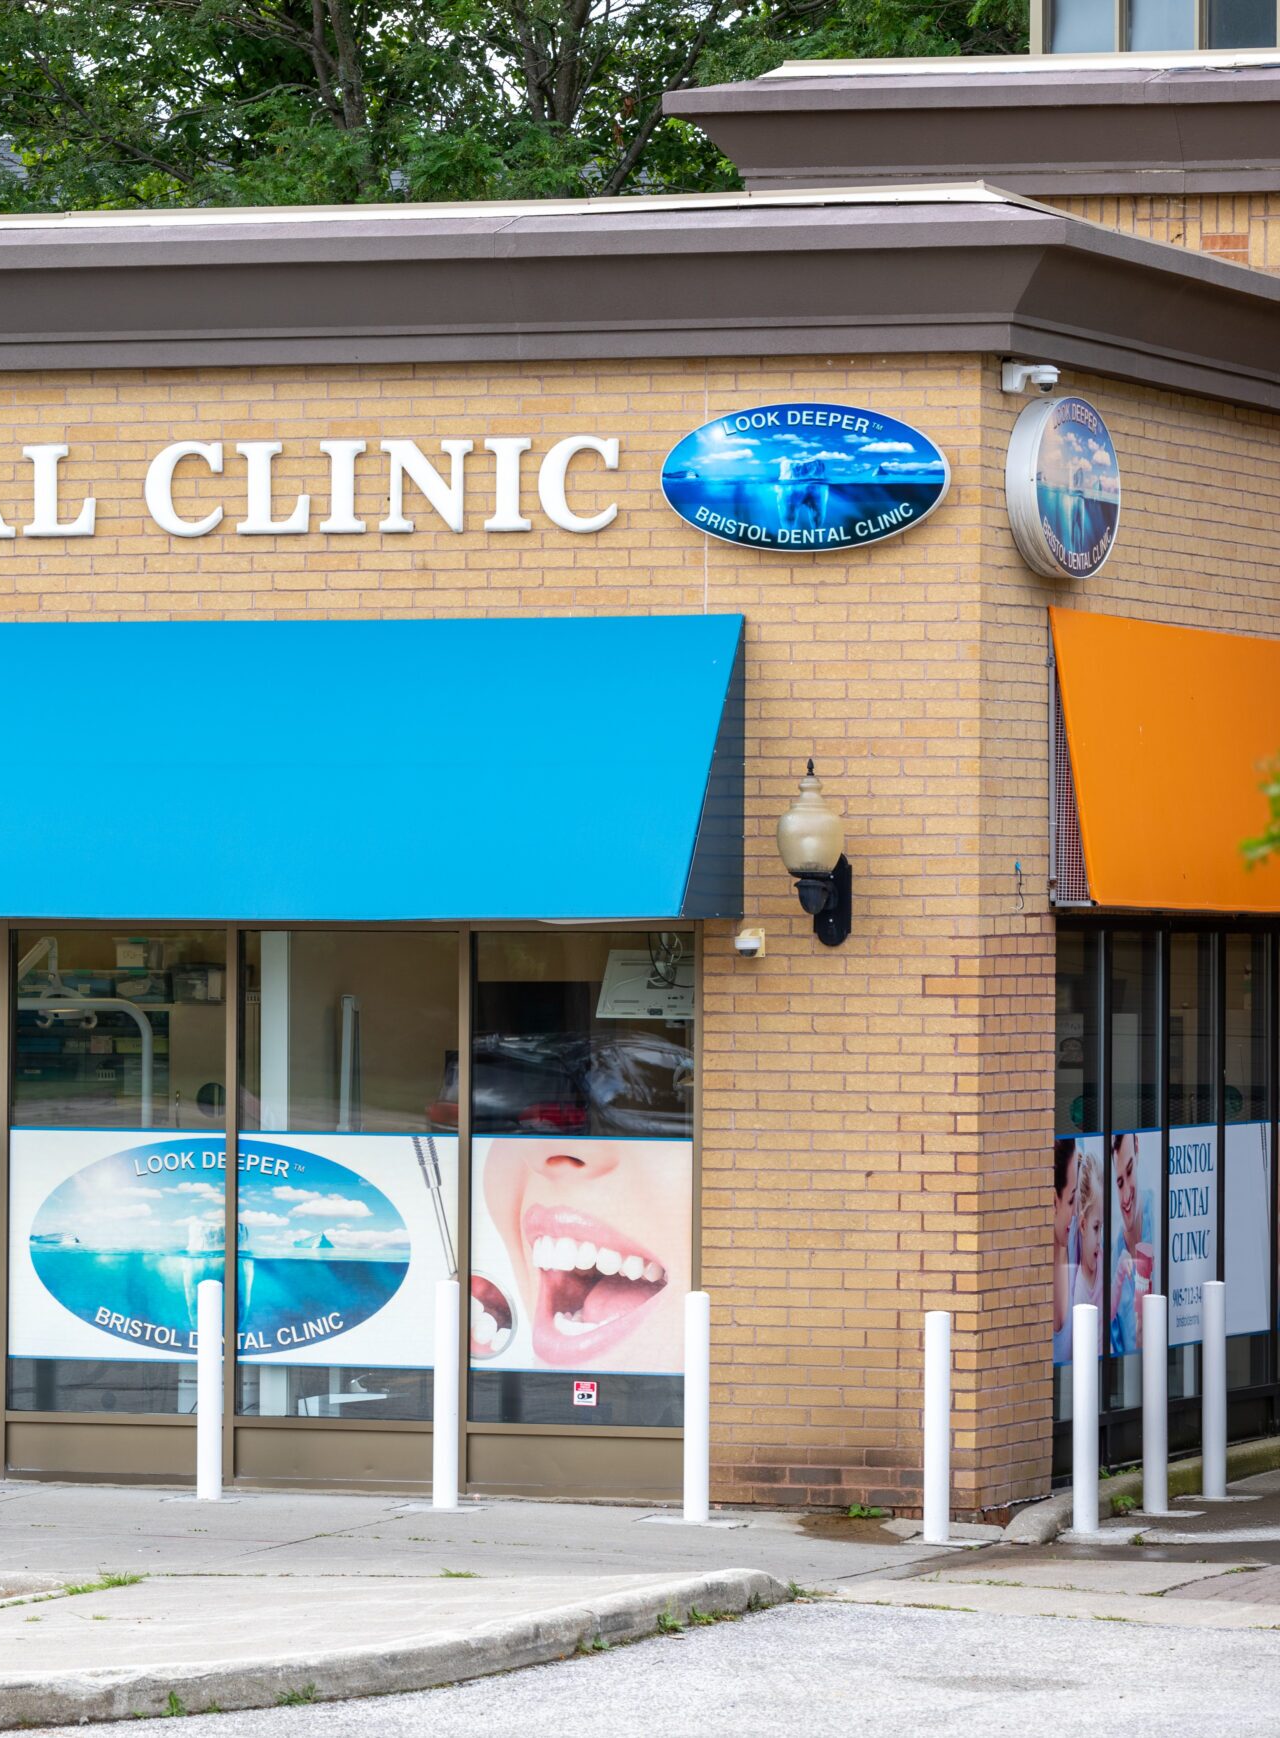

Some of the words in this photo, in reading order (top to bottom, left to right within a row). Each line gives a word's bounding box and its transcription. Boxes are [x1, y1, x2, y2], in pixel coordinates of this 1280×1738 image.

[723, 412, 780, 436] LOOK
[787, 411, 869, 433] DEEPER
[1053, 403, 1070, 429] LOOK
[1072, 403, 1097, 435] DEEPER
[145, 435, 619, 537] CLINIC
[695, 506, 771, 542] BRISTOL
[777, 526, 851, 544] DENTAL
[855, 502, 914, 537] CLINIC
[1042, 517, 1068, 565] BRISTOL
[1068, 550, 1093, 571] DENTAL
[1092, 527, 1112, 564] CLINIC
[134, 1152, 195, 1176] LOOK
[1169, 1143, 1214, 1175] BRISTOL
[1172, 1230, 1210, 1263] CLINIC
[94, 1306, 182, 1347] BRISTOL
[188, 1331, 272, 1350] DTAL
[276, 1312, 344, 1346] CLINIC
